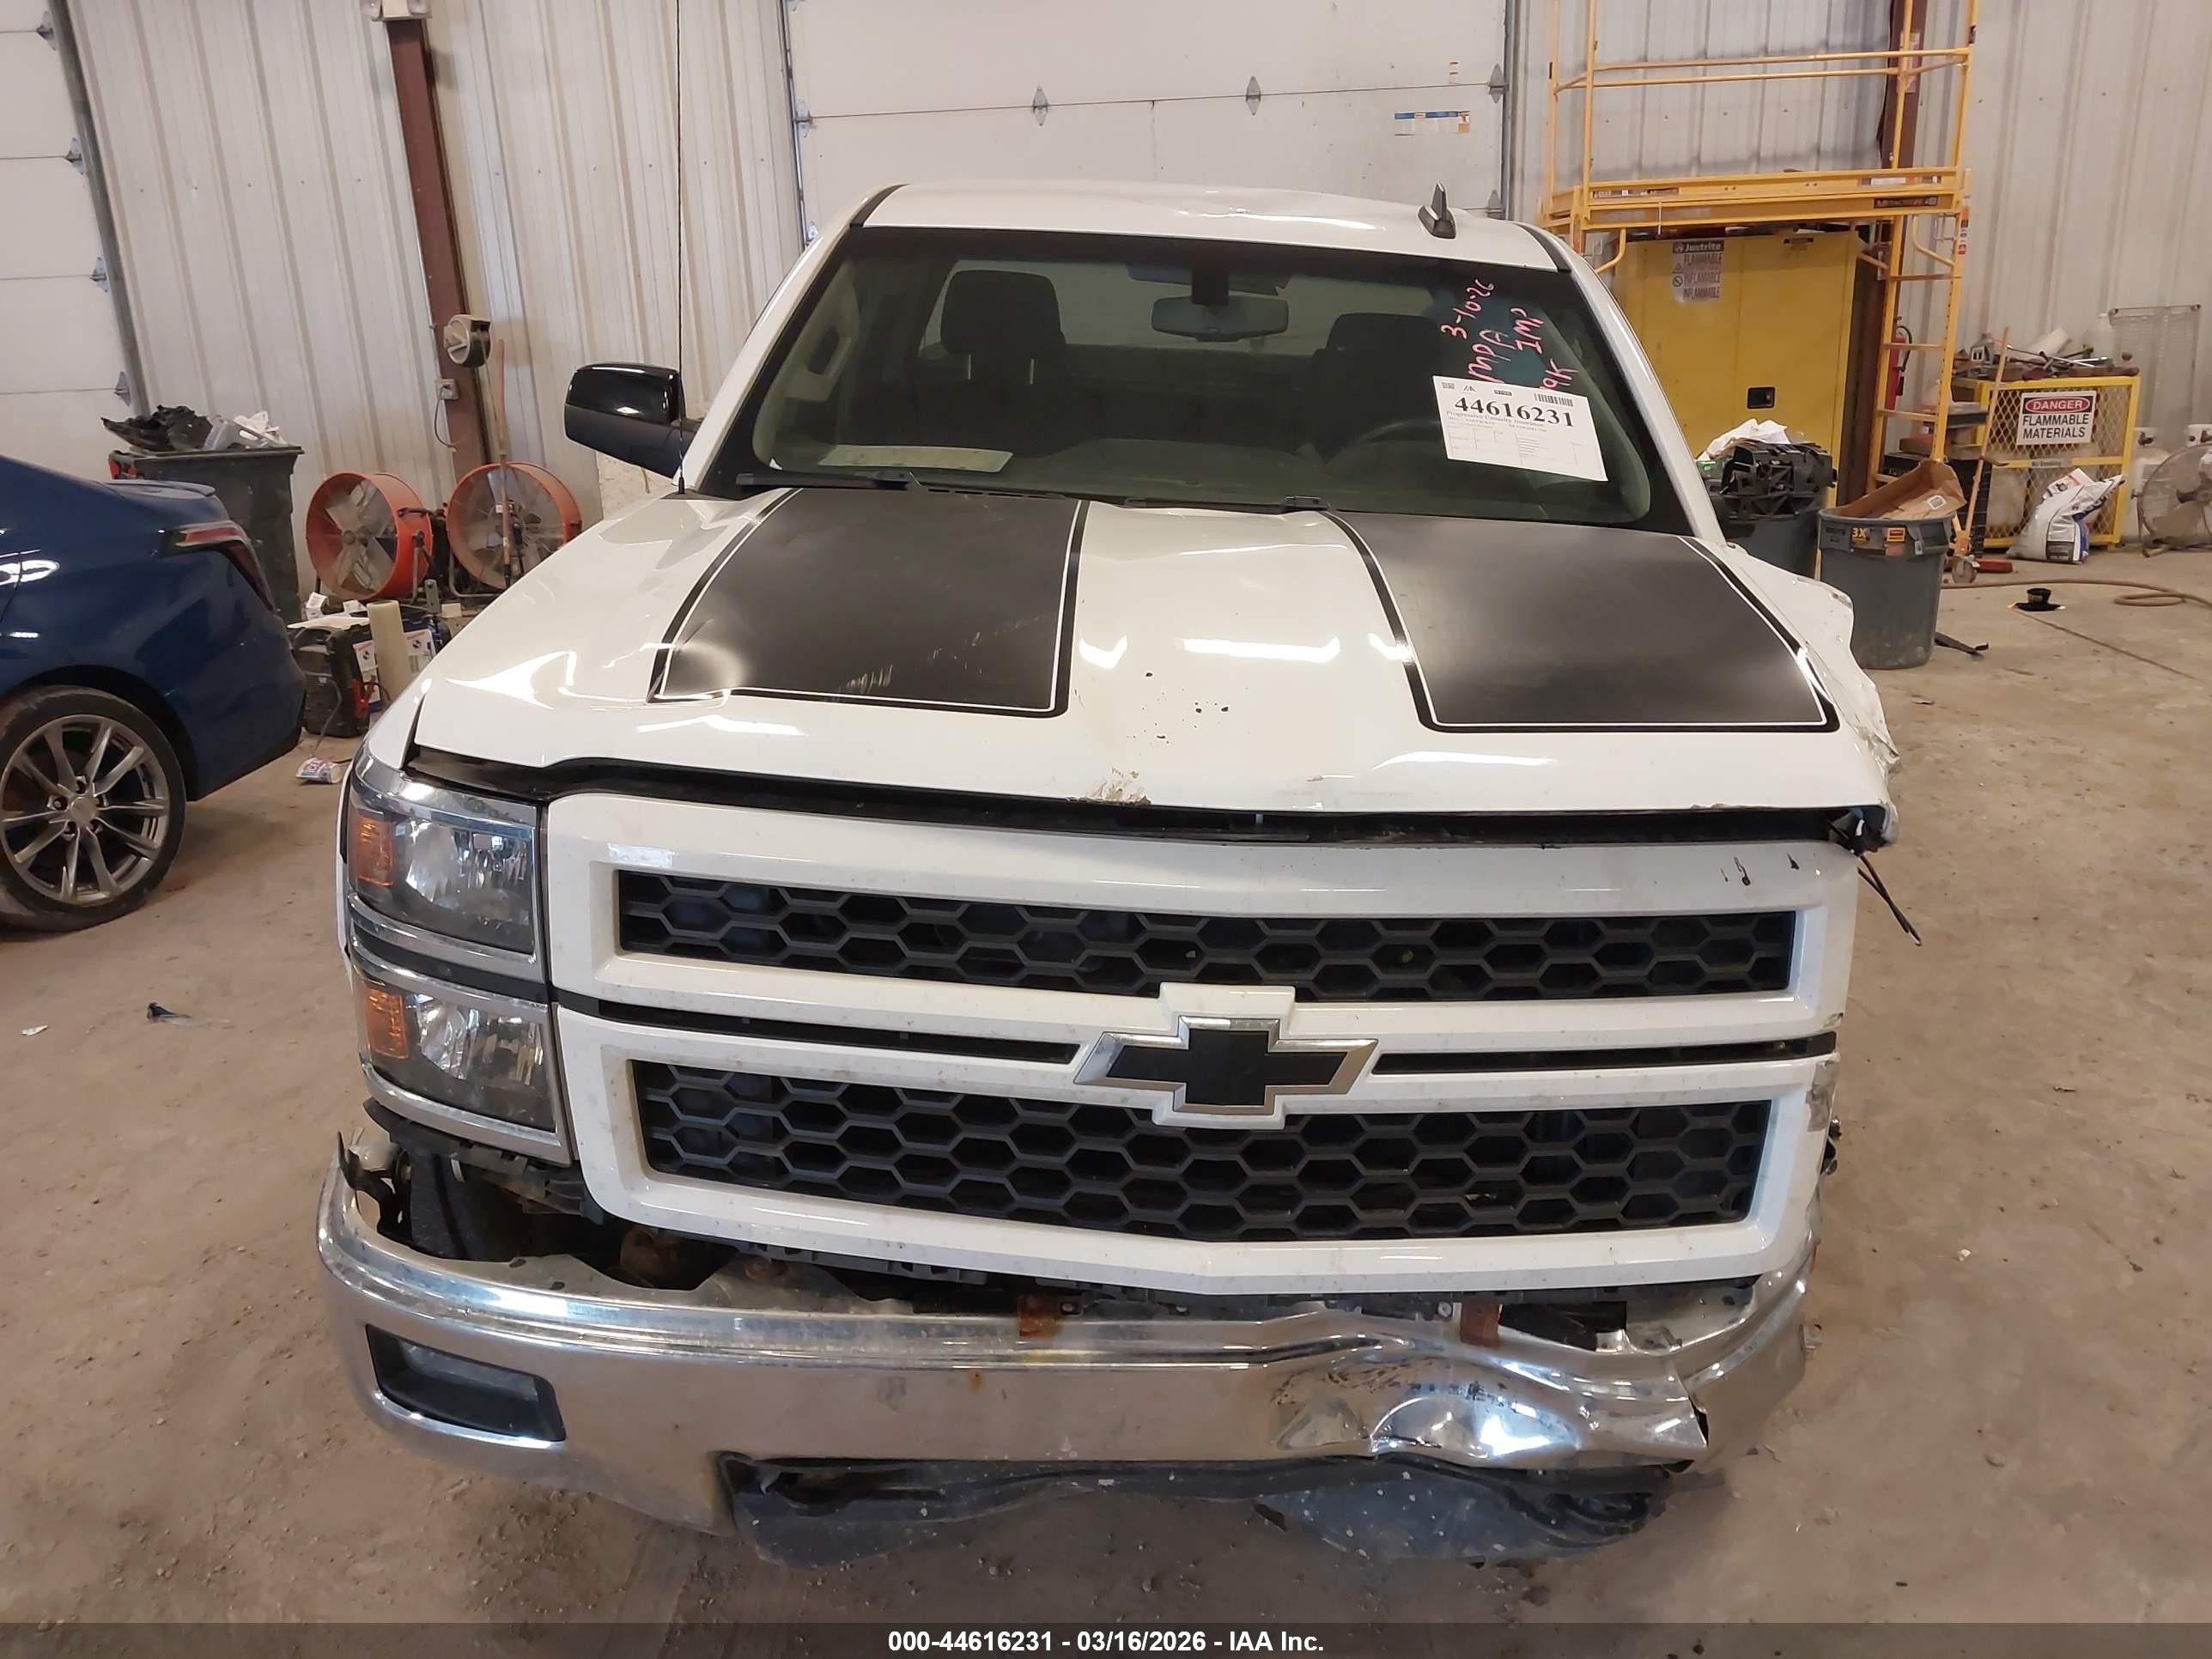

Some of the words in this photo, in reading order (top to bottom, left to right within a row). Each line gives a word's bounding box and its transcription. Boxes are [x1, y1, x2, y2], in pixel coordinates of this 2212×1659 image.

[2033, 399, 2083, 410] DANGER
[1455, 397, 1574, 427] 44616231
[2022, 413, 2089, 427] FLAMMABLE
[2022, 427, 2086, 440] MATERIALS
[1852, 527, 1868, 538] 3X
